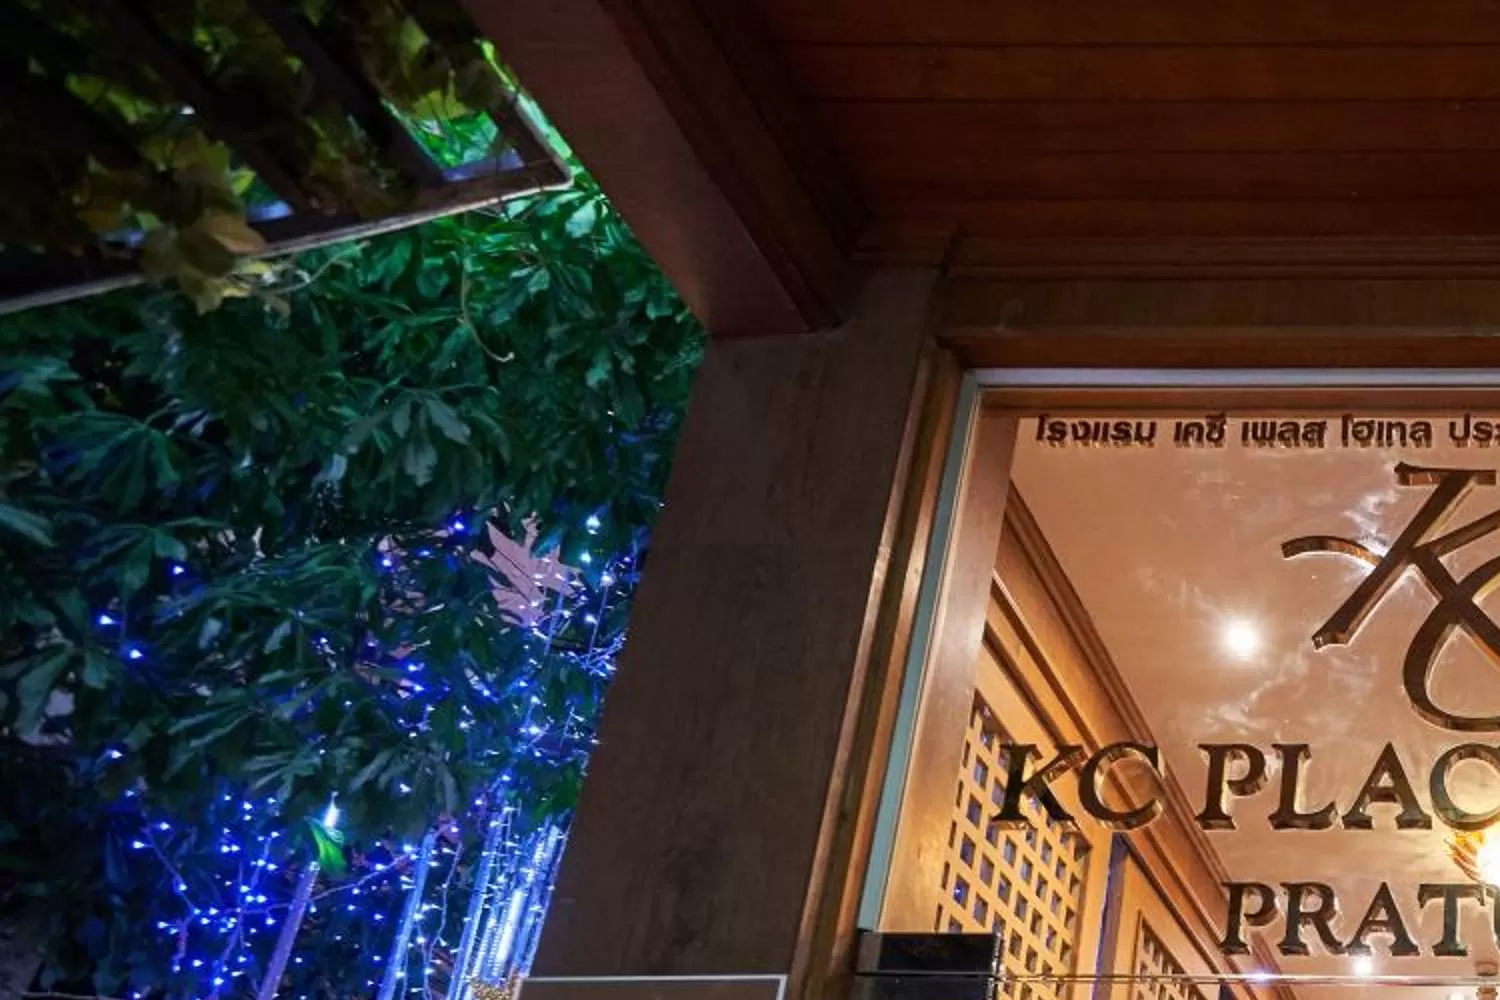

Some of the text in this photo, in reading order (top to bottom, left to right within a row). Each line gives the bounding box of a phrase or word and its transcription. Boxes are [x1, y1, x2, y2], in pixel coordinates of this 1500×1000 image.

[1035, 414, 1158, 448] โรงแรม
[1241, 419, 1327, 448] เพลส
[1341, 413, 1433, 448] โฮเทล
[996, 742, 1164, 834] KC
